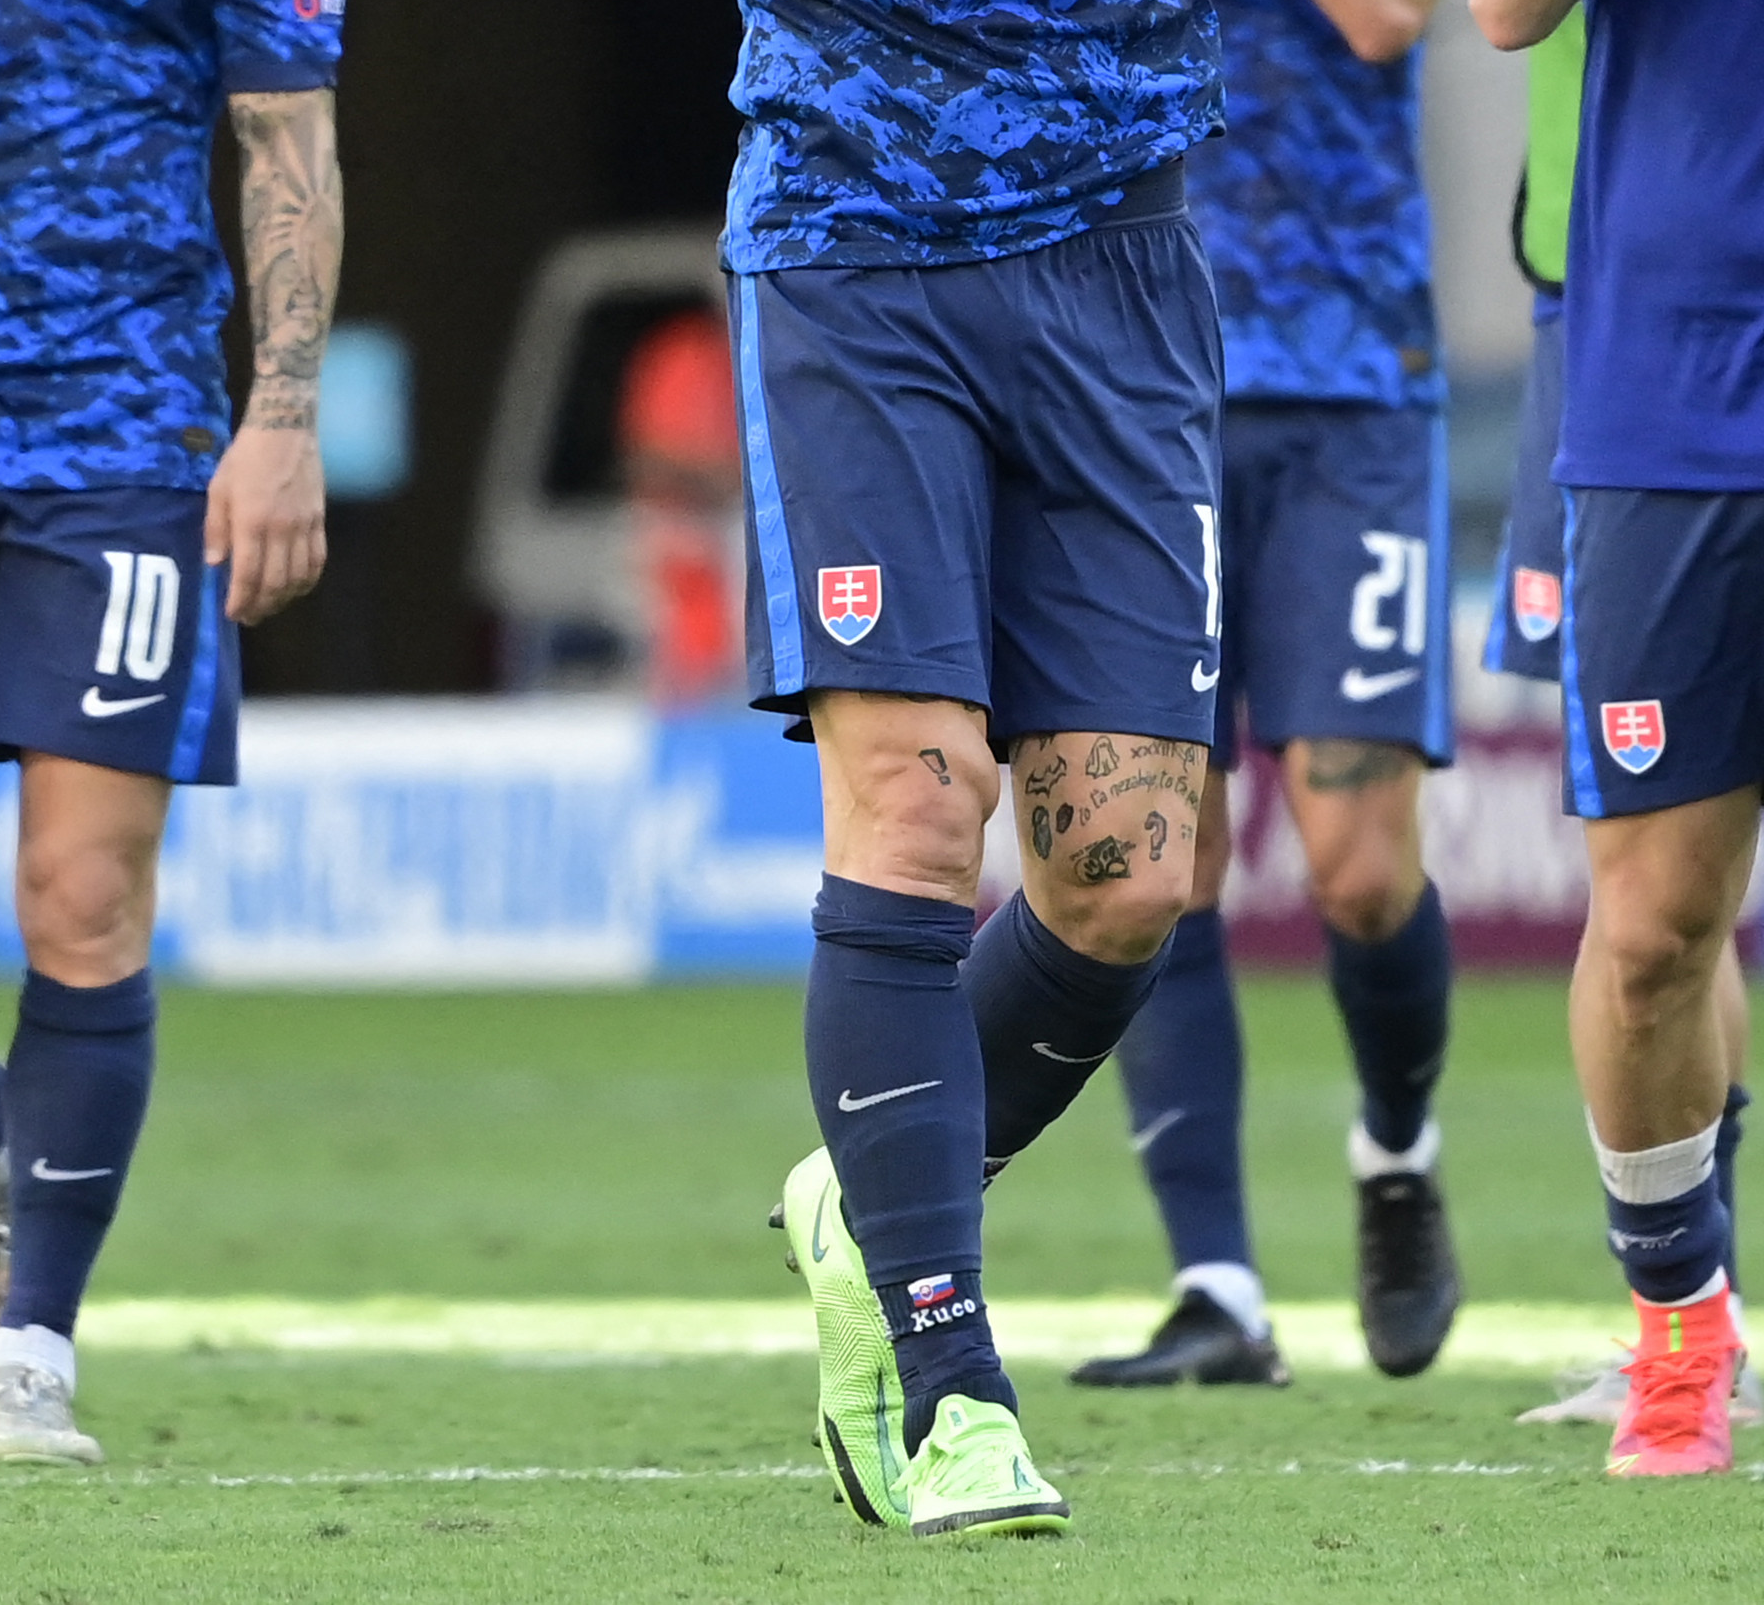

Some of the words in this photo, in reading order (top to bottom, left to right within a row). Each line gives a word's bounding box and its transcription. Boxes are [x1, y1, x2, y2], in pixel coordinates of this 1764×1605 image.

[94, 550, 182, 682] 10
[1193, 504, 1222, 639] 1
[1349, 531, 1429, 656] 21
[911, 1298, 976, 1333] Kuco
